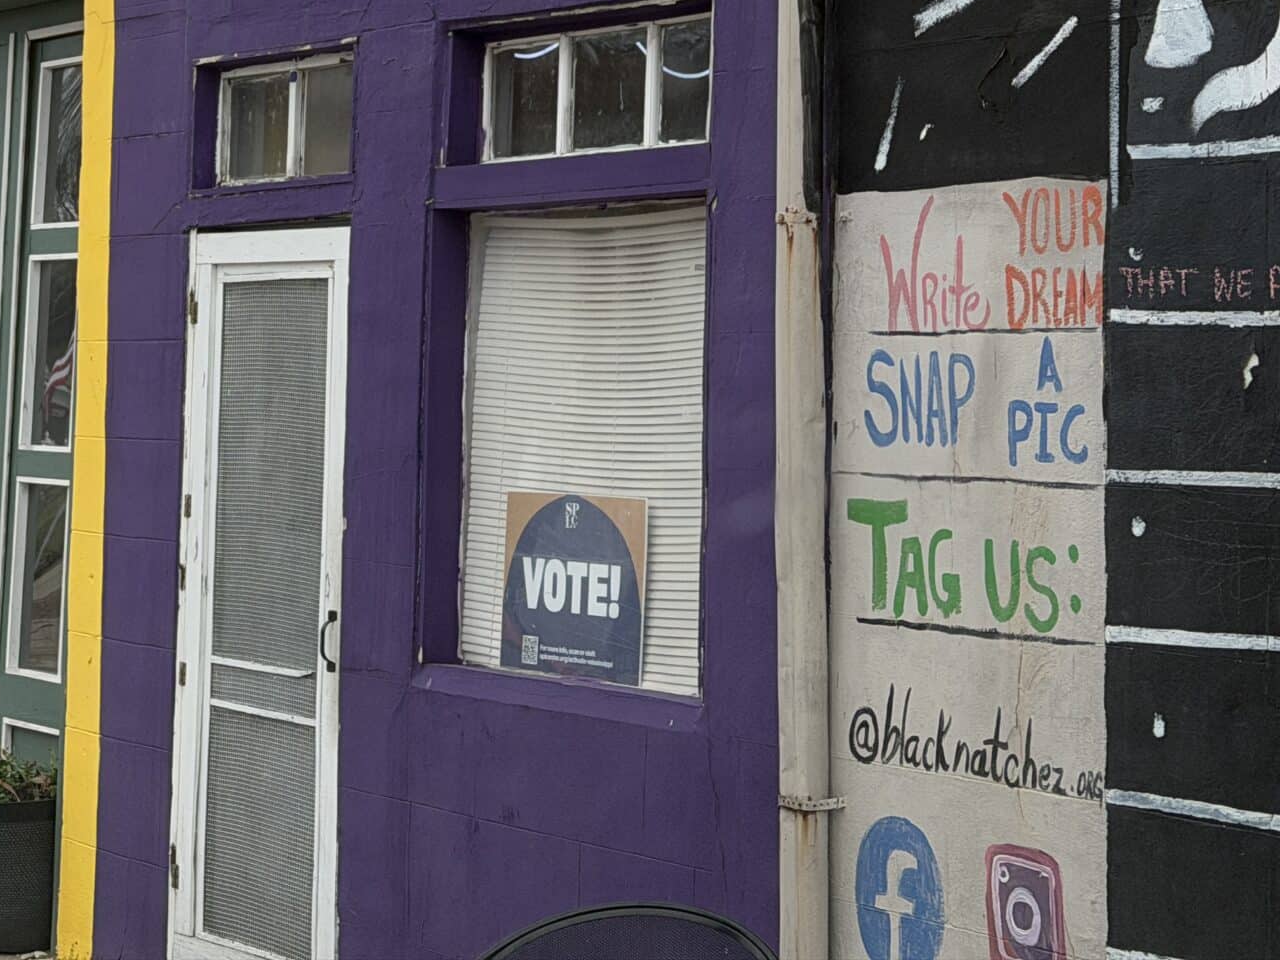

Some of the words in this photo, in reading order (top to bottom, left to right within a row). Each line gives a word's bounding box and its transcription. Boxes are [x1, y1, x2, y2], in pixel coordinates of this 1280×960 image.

[1002, 185, 1104, 256] YOUR
[880, 195, 992, 333] Write
[1005, 263, 1104, 330] DREAM
[1119, 266, 1200, 300] THAT
[1213, 266, 1254, 302] WE
[864, 348, 976, 447] SNAP
[1037, 336, 1062, 392] A
[1008, 400, 1089, 466] PIC
[522, 556, 621, 619] VOTE!
[847, 498, 962, 619] TAG
[984, 538, 1082, 633] US:
